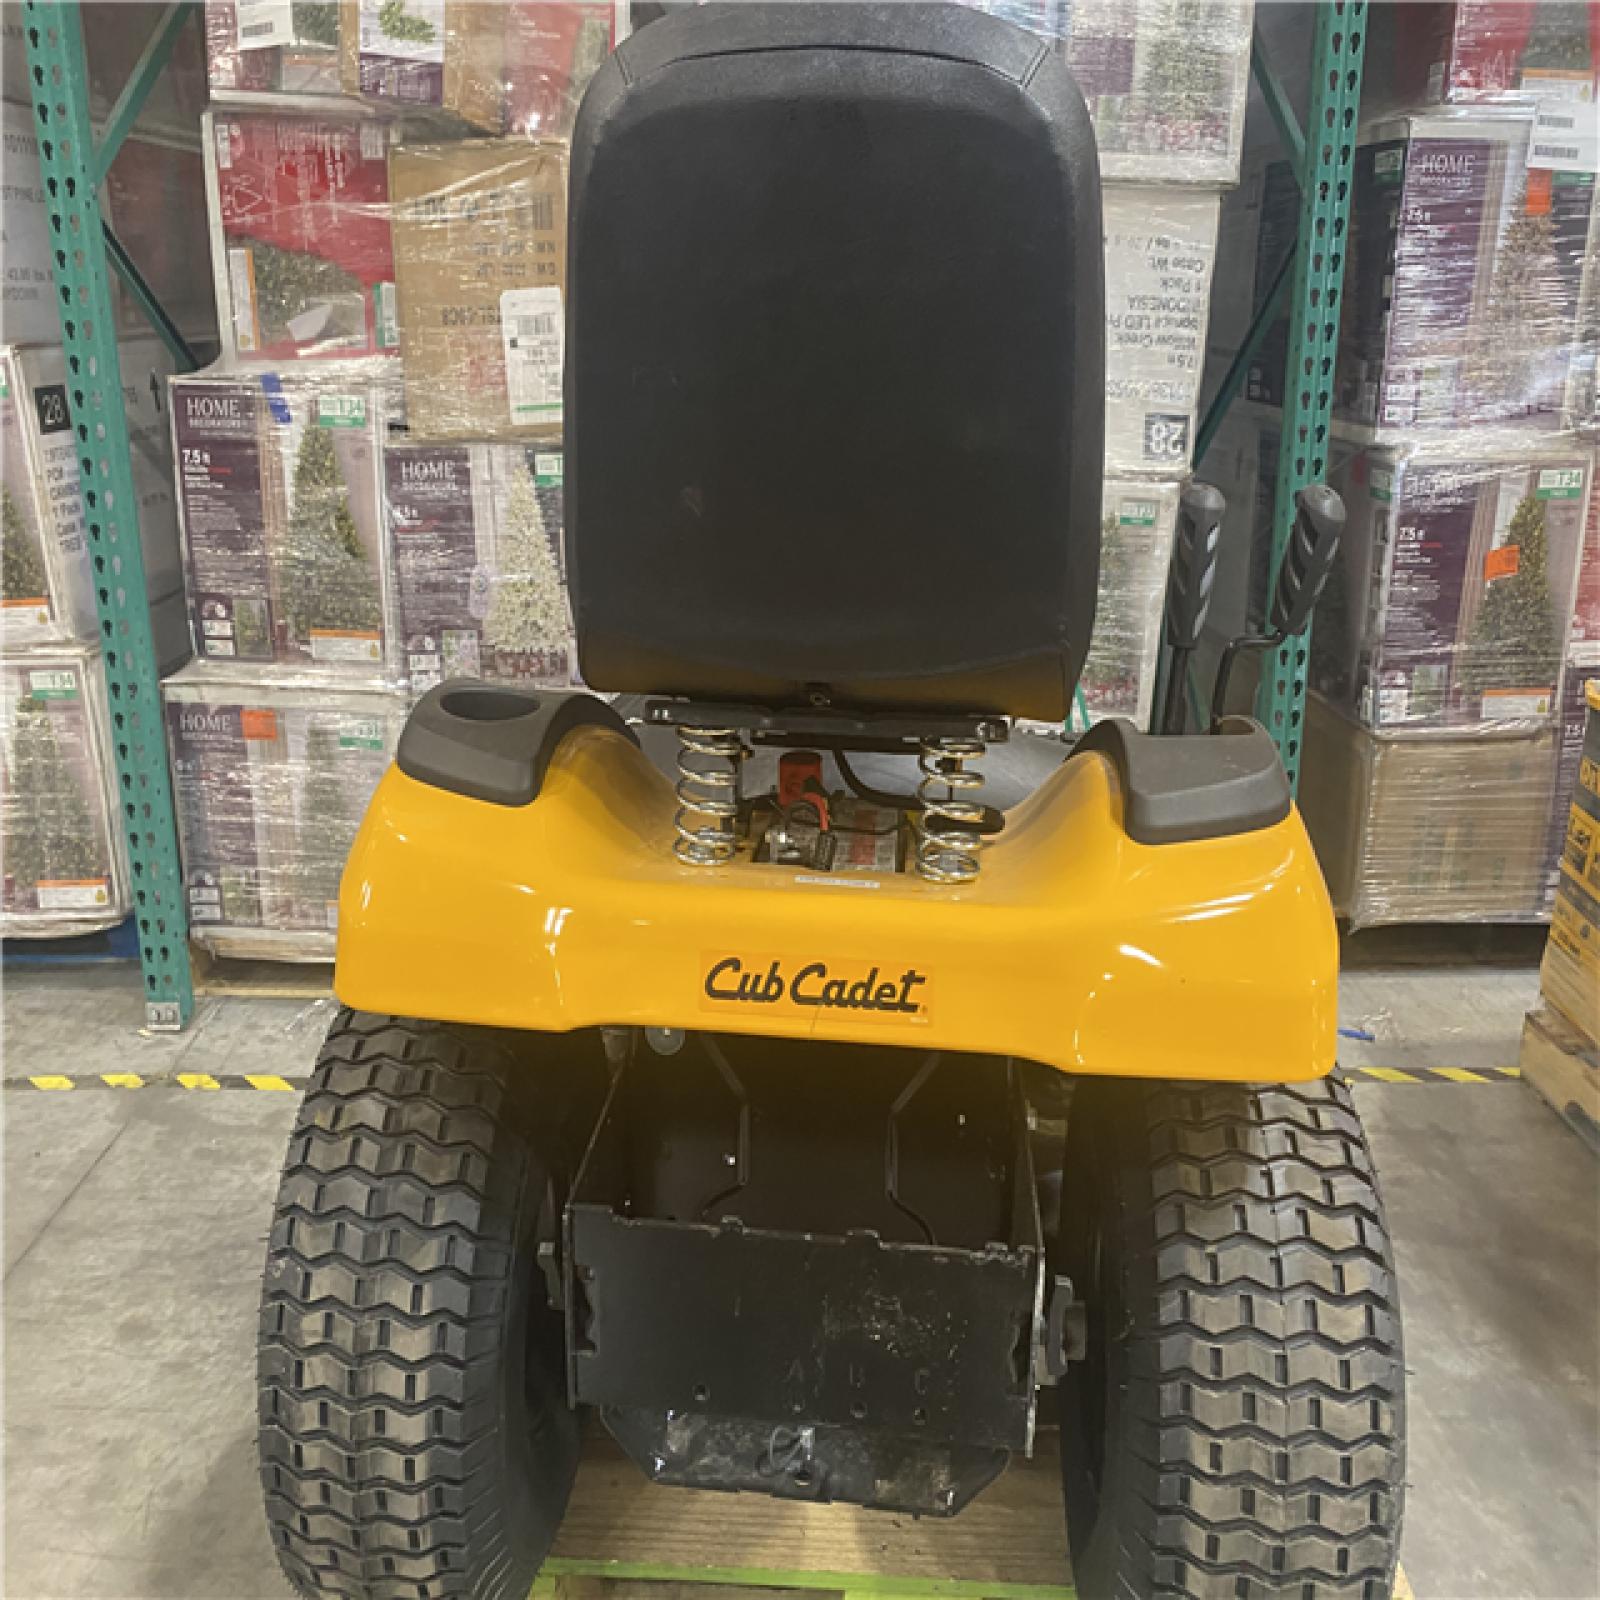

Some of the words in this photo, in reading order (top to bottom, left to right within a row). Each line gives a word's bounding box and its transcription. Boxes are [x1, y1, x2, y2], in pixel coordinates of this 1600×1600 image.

[1422, 154, 1475, 173] HOME
[42, 395, 65, 426] 28
[187, 396, 240, 417] HOME
[1151, 421, 1185, 454] 28
[402, 460, 457, 480] HOME
[180, 714, 233, 731] HOME
[705, 957, 785, 1003] Cub
[789, 962, 926, 1013] Cadet
